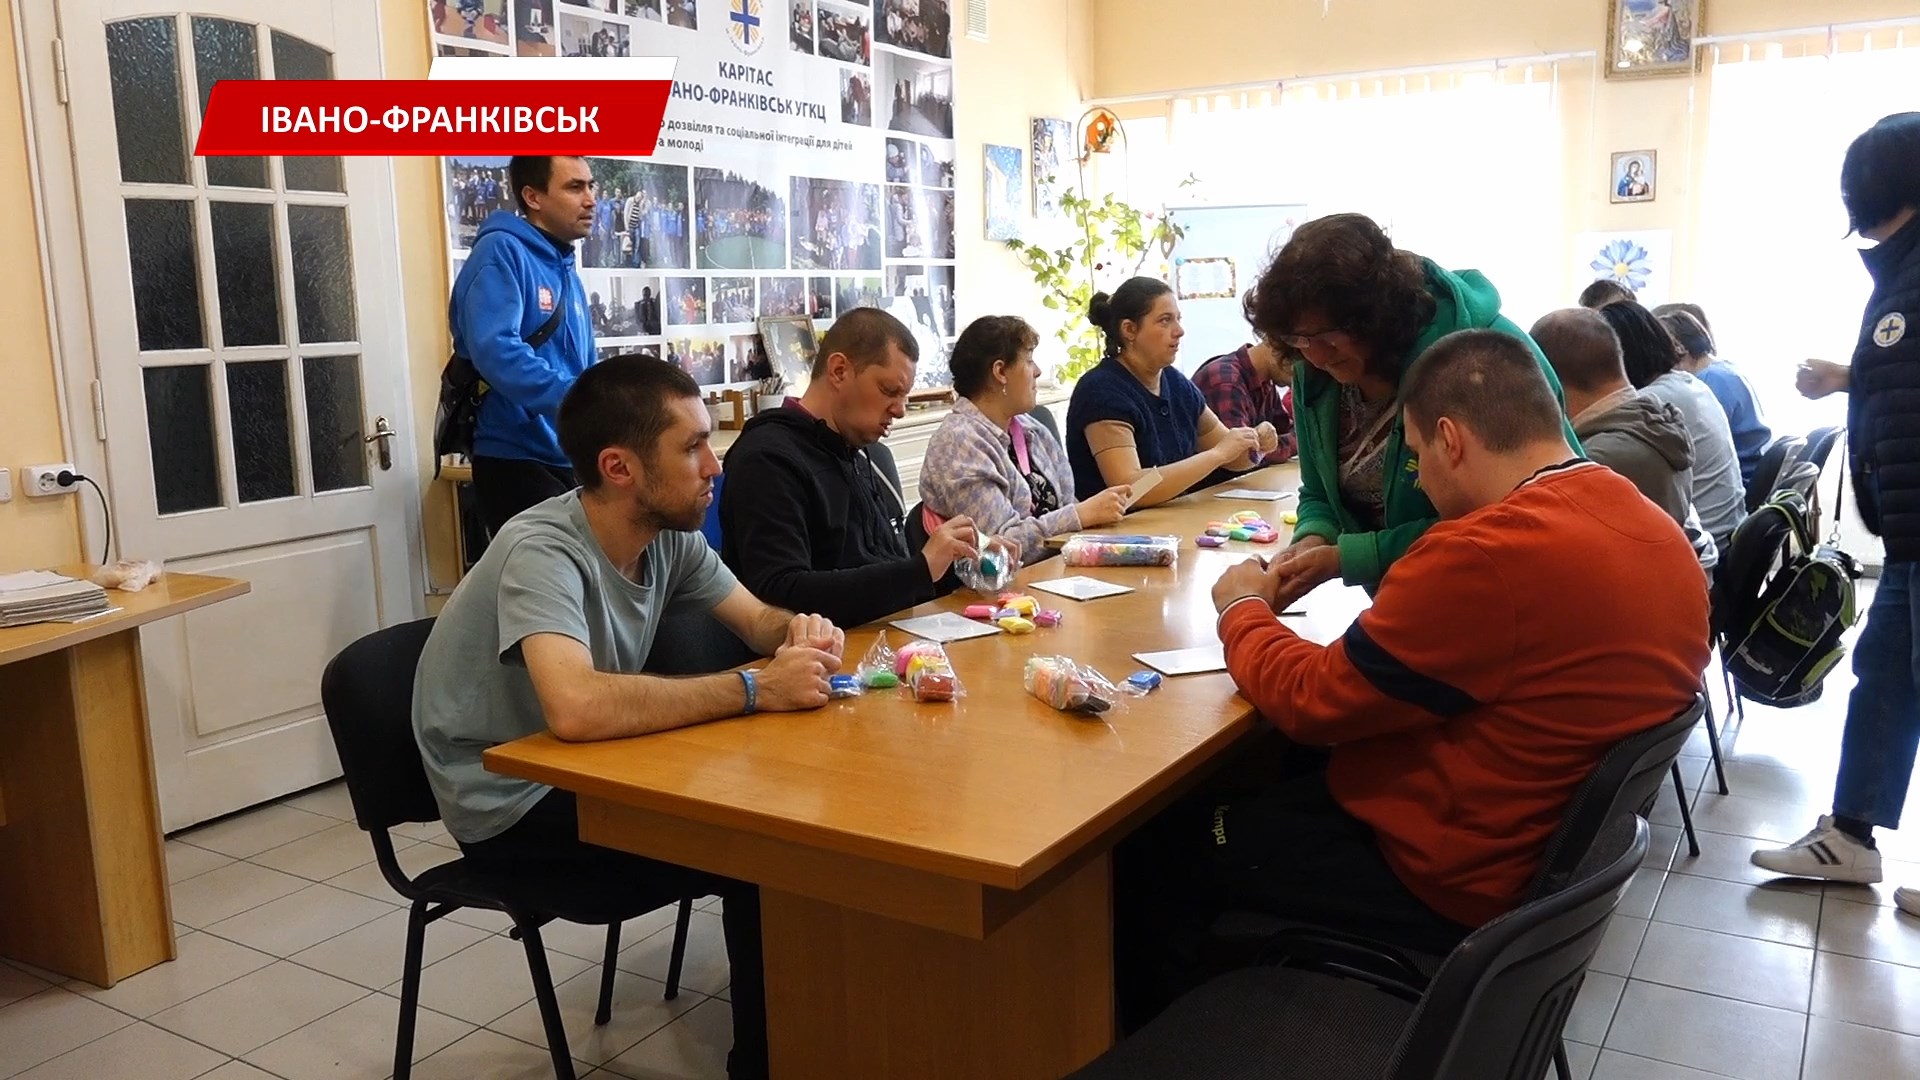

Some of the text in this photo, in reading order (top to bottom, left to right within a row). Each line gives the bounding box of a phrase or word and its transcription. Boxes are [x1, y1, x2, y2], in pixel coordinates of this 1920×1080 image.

[718, 61, 774, 87] КАРІТАС
[671, 80, 826, 123] АНО-ФРАНКІВСЬК УГКЦ
[667, 119, 713, 134] дозвілля
[715, 125, 725, 136] та
[726, 126, 774, 142] соціальної
[775, 130, 815, 149] інтеграції
[816, 138, 831, 150] для
[833, 138, 853, 151] дітей
[667, 138, 704, 152] молоді
